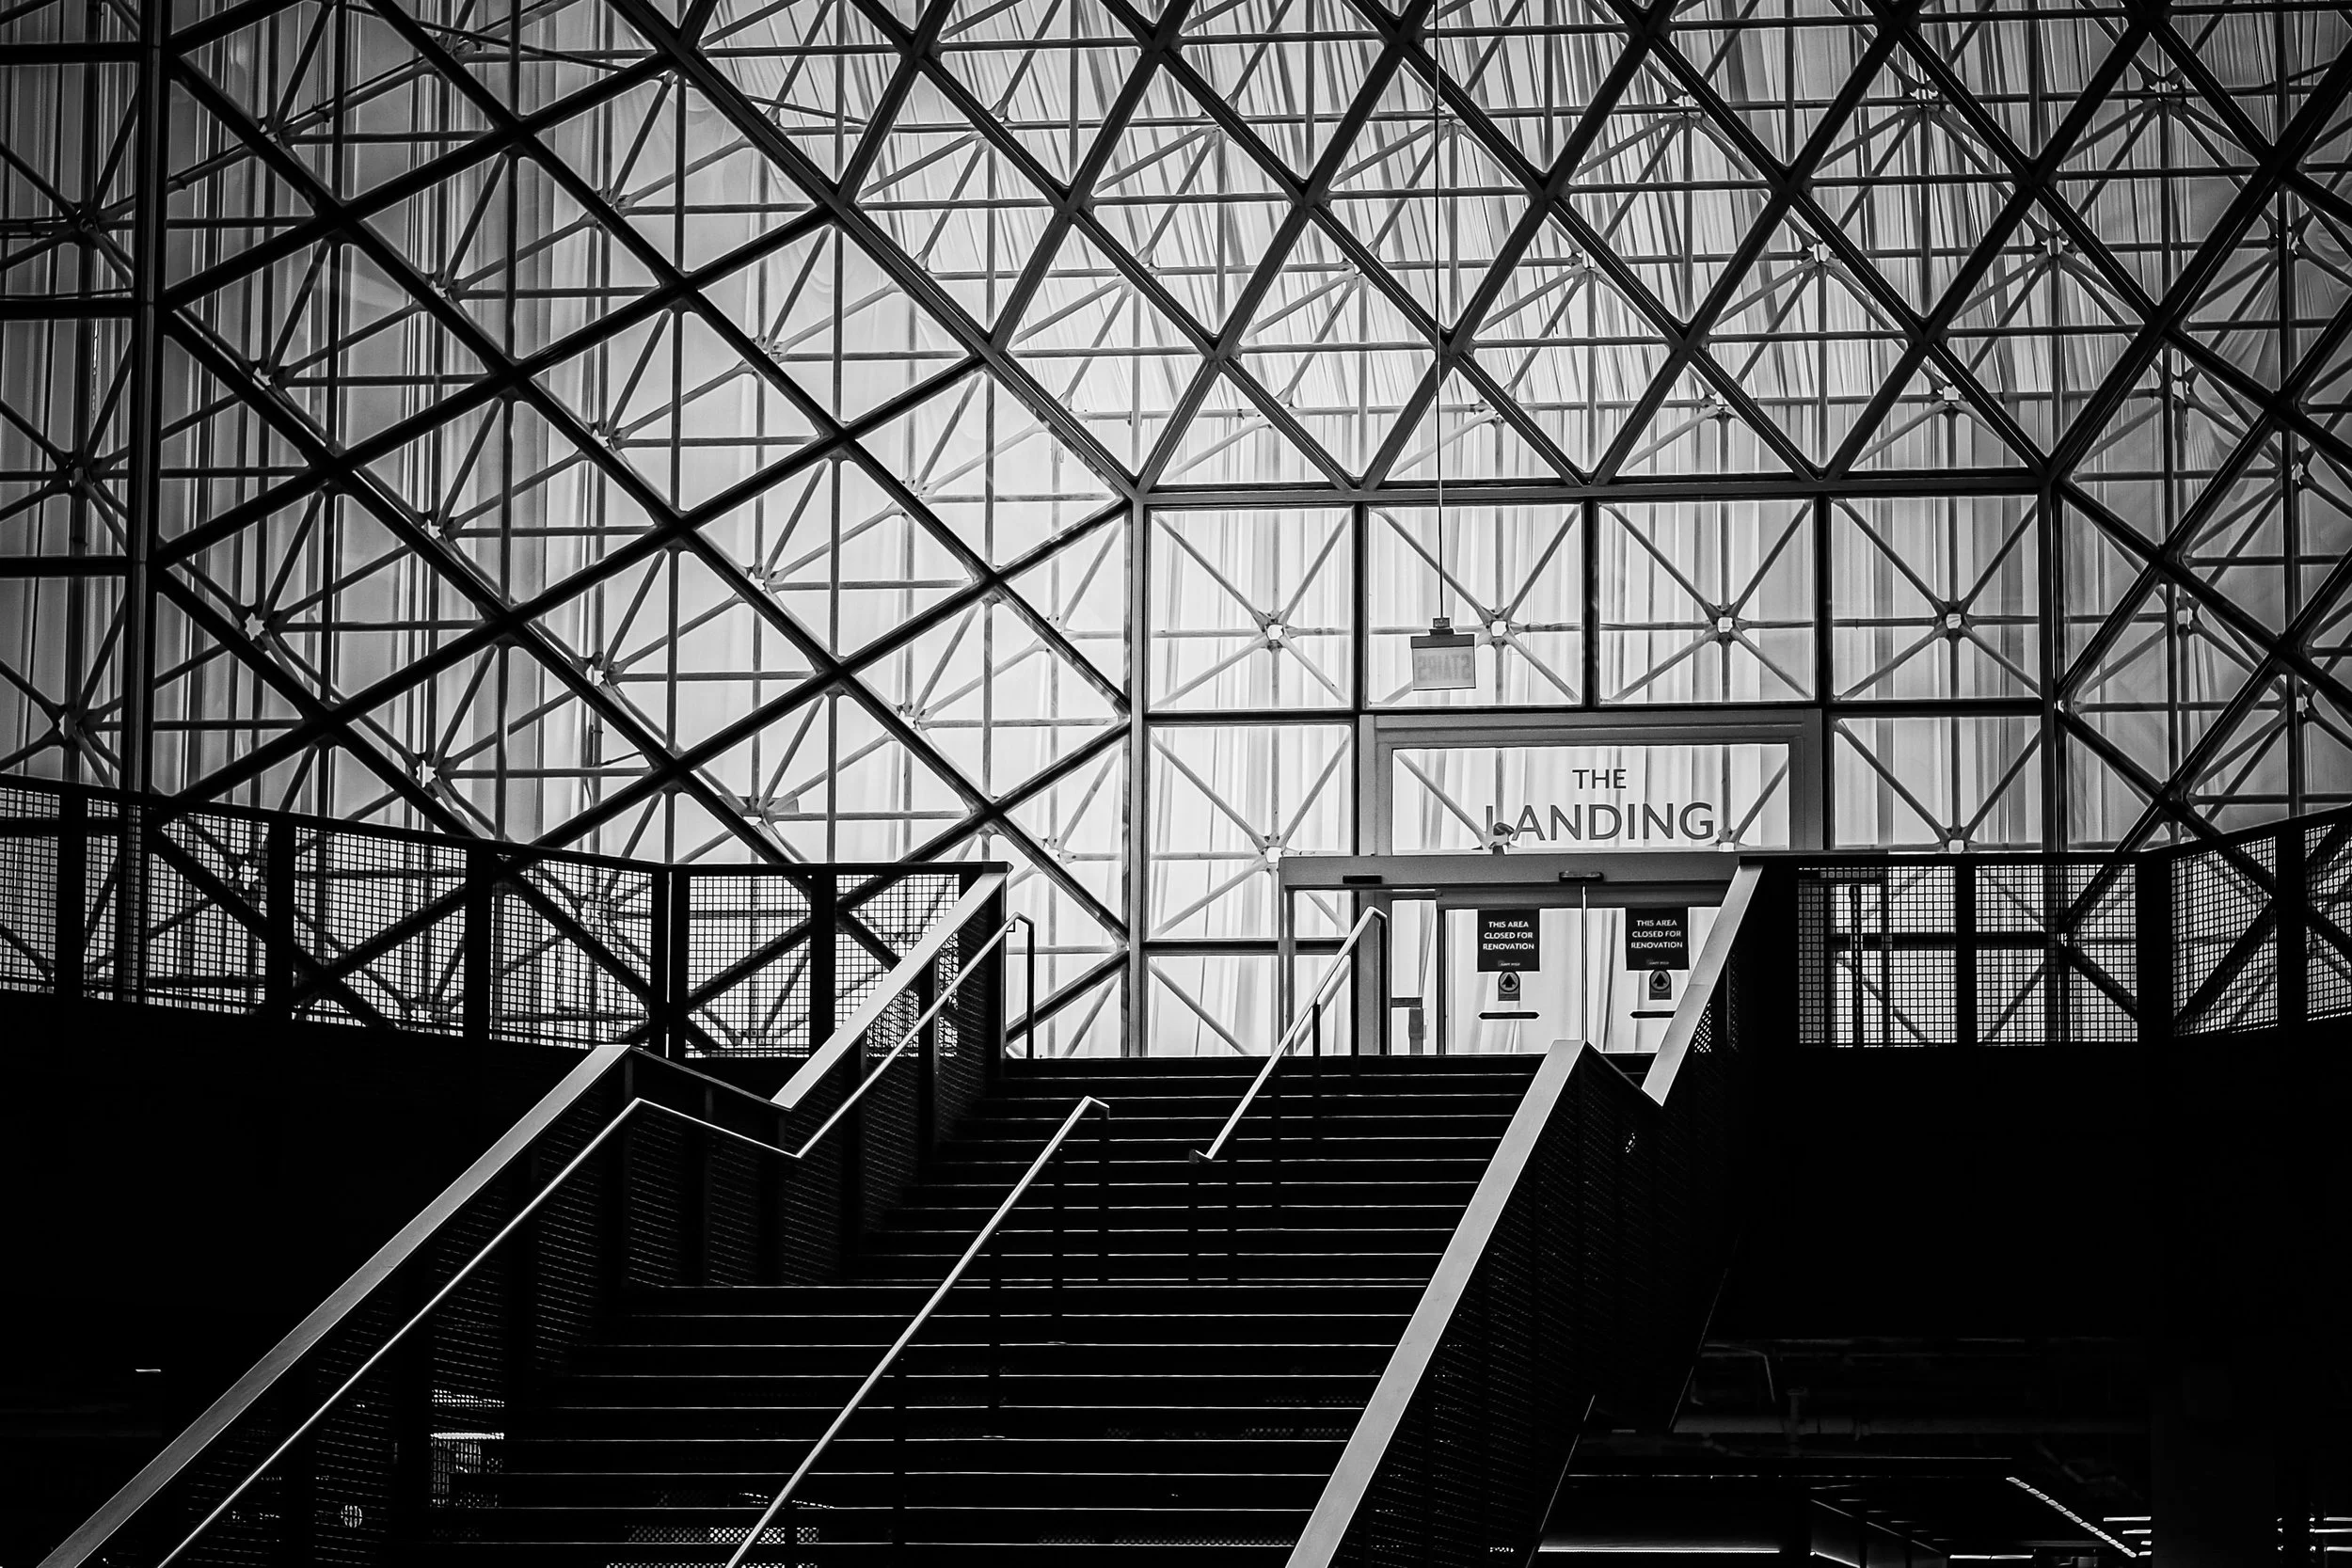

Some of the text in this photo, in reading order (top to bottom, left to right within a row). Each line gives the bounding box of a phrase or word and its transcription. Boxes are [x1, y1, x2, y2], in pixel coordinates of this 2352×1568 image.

[1572, 768, 1627, 789] THE
[1486, 802, 1714, 841] LANDING
[1484, 931, 1516, 940] CLOSED
